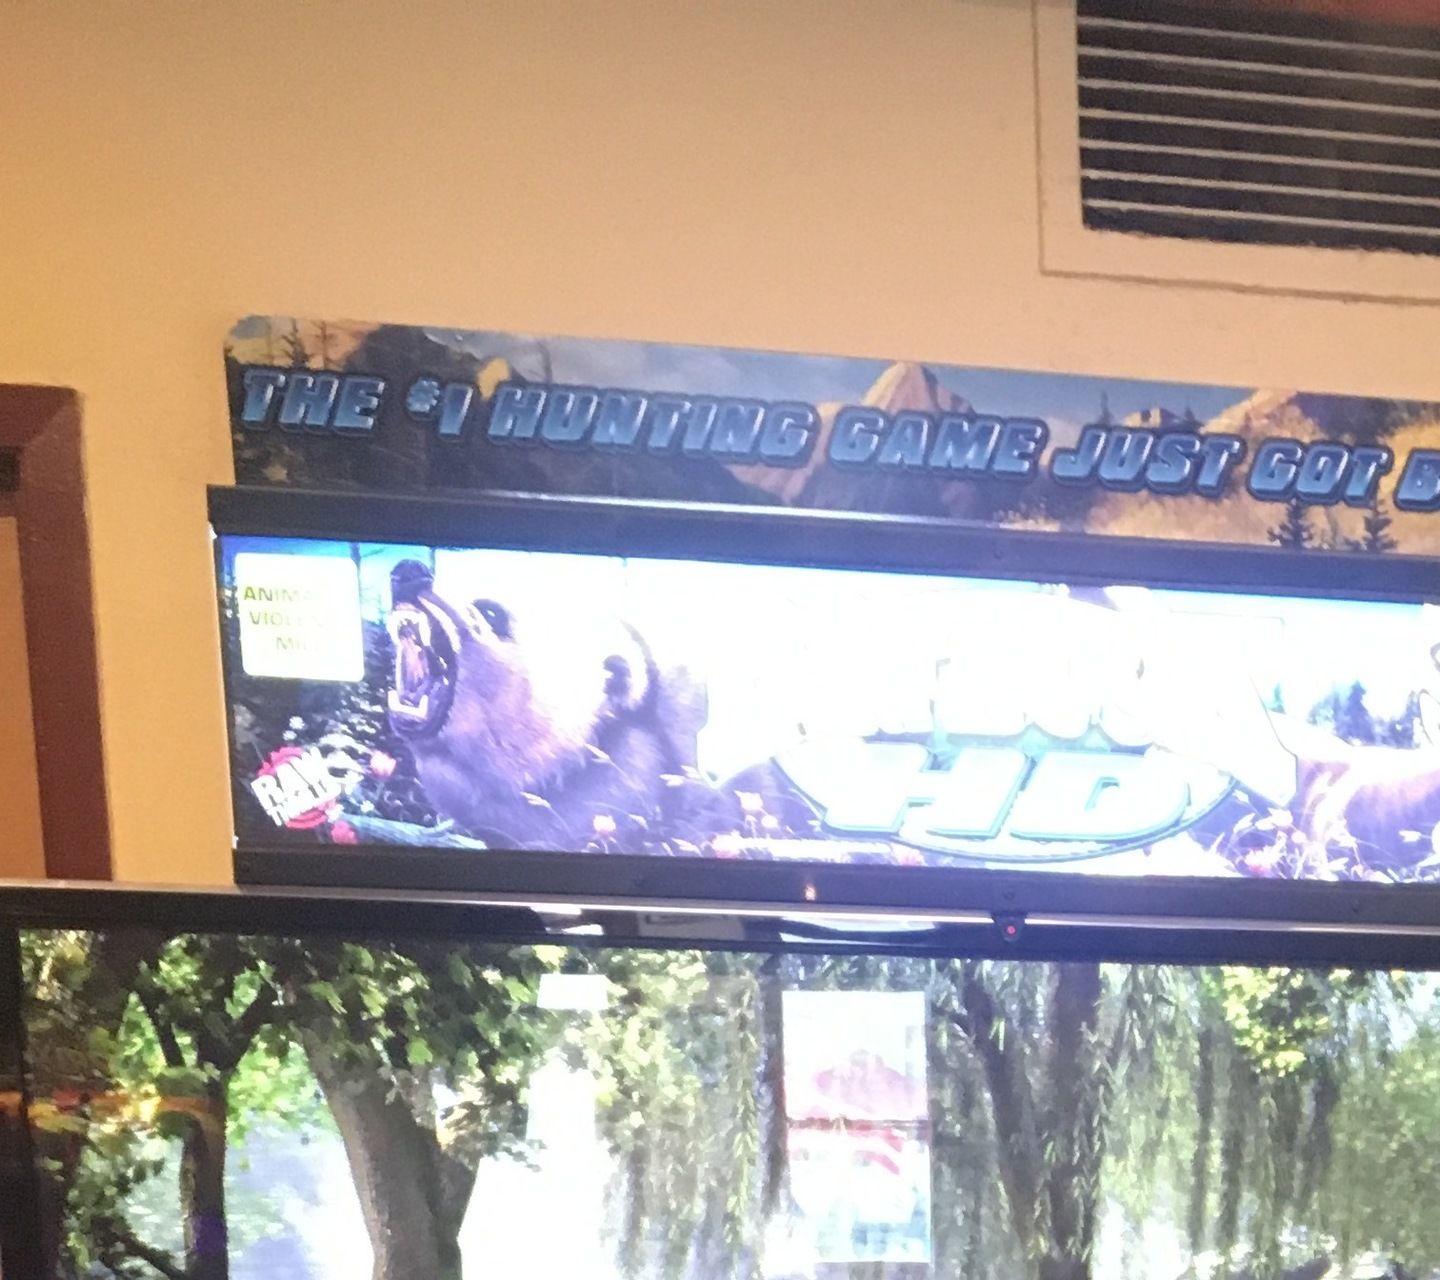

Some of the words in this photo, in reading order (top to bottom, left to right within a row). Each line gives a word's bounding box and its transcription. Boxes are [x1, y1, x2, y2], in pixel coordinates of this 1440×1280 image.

[238, 371, 386, 432] THE
[487, 385, 817, 465] HUNTING
[828, 405, 1047, 479] GAME
[1053, 421, 1245, 495] JUST
[1249, 441, 1391, 502] GOT
